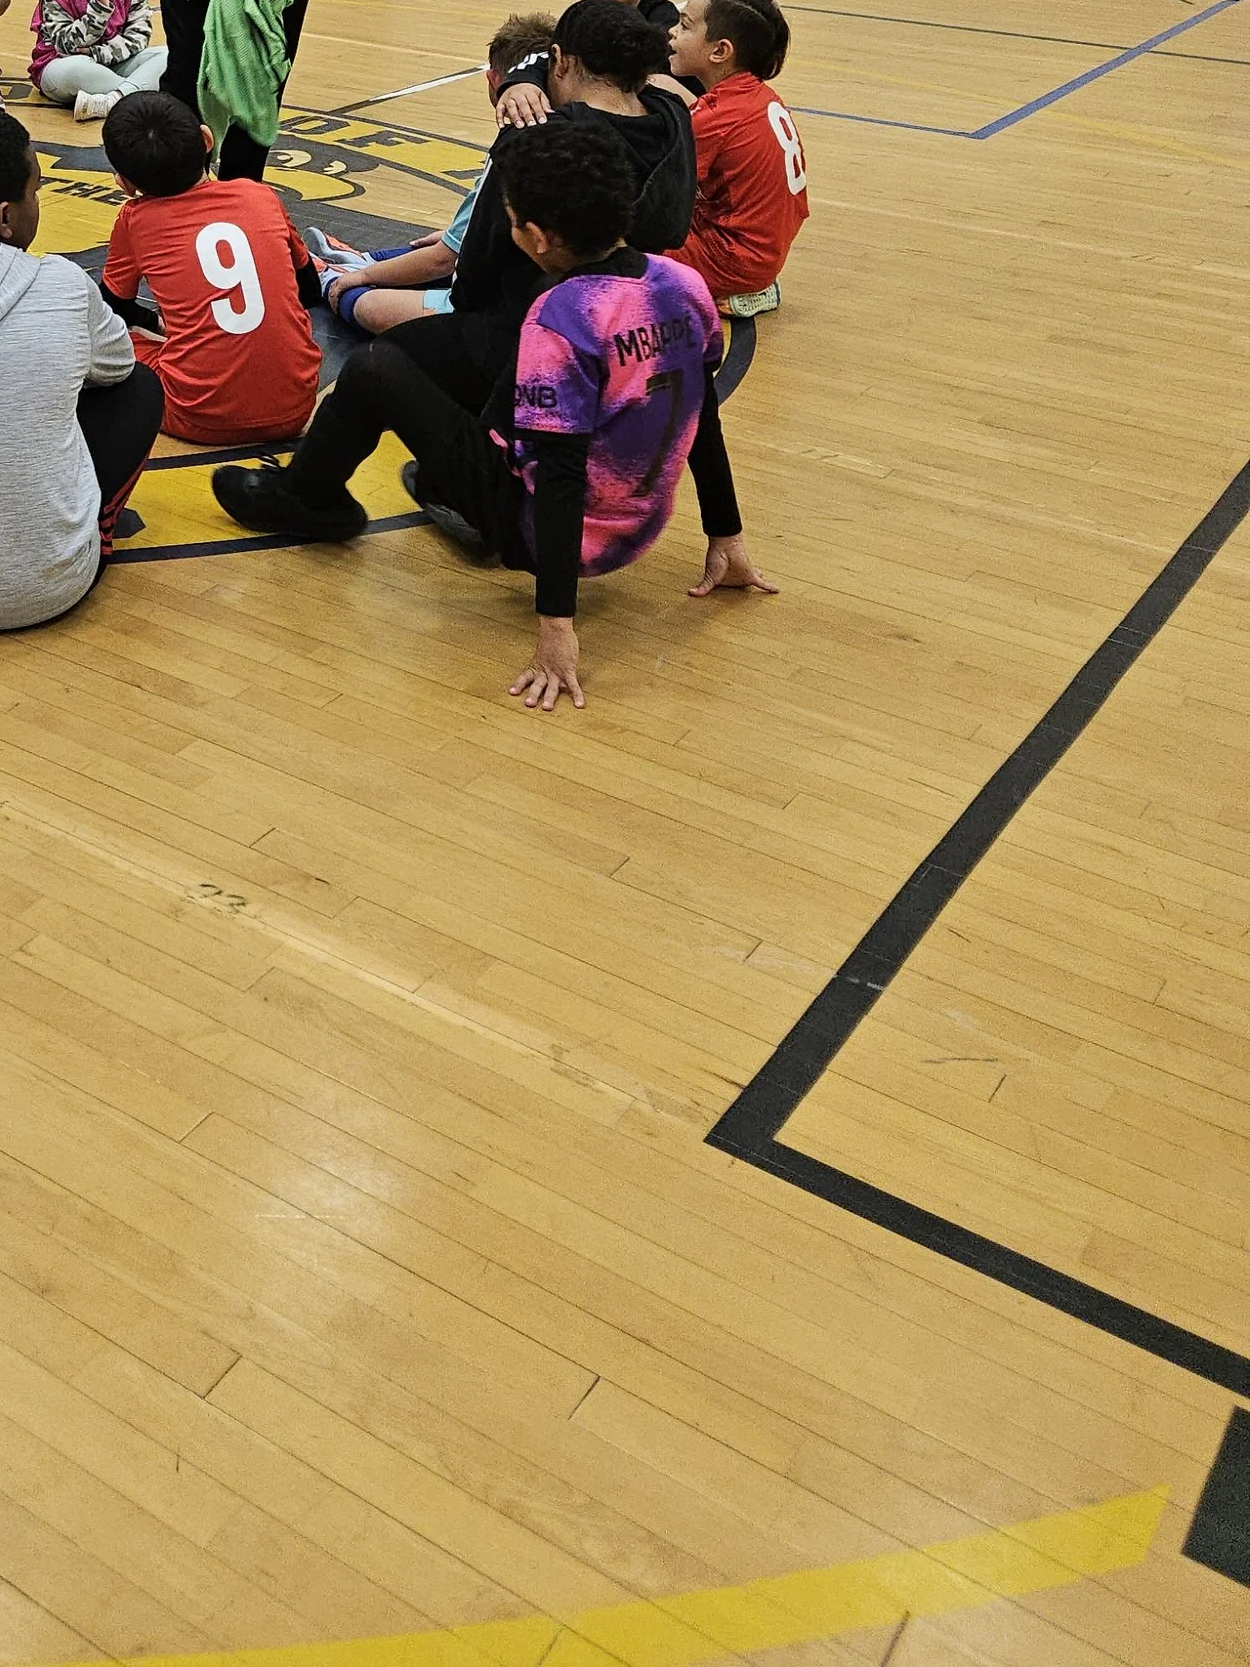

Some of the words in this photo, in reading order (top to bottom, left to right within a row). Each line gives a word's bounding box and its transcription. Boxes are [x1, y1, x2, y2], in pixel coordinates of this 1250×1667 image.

[767, 100, 807, 196] 8
[195, 221, 266, 335] 9
[630, 368, 684, 497] 7
